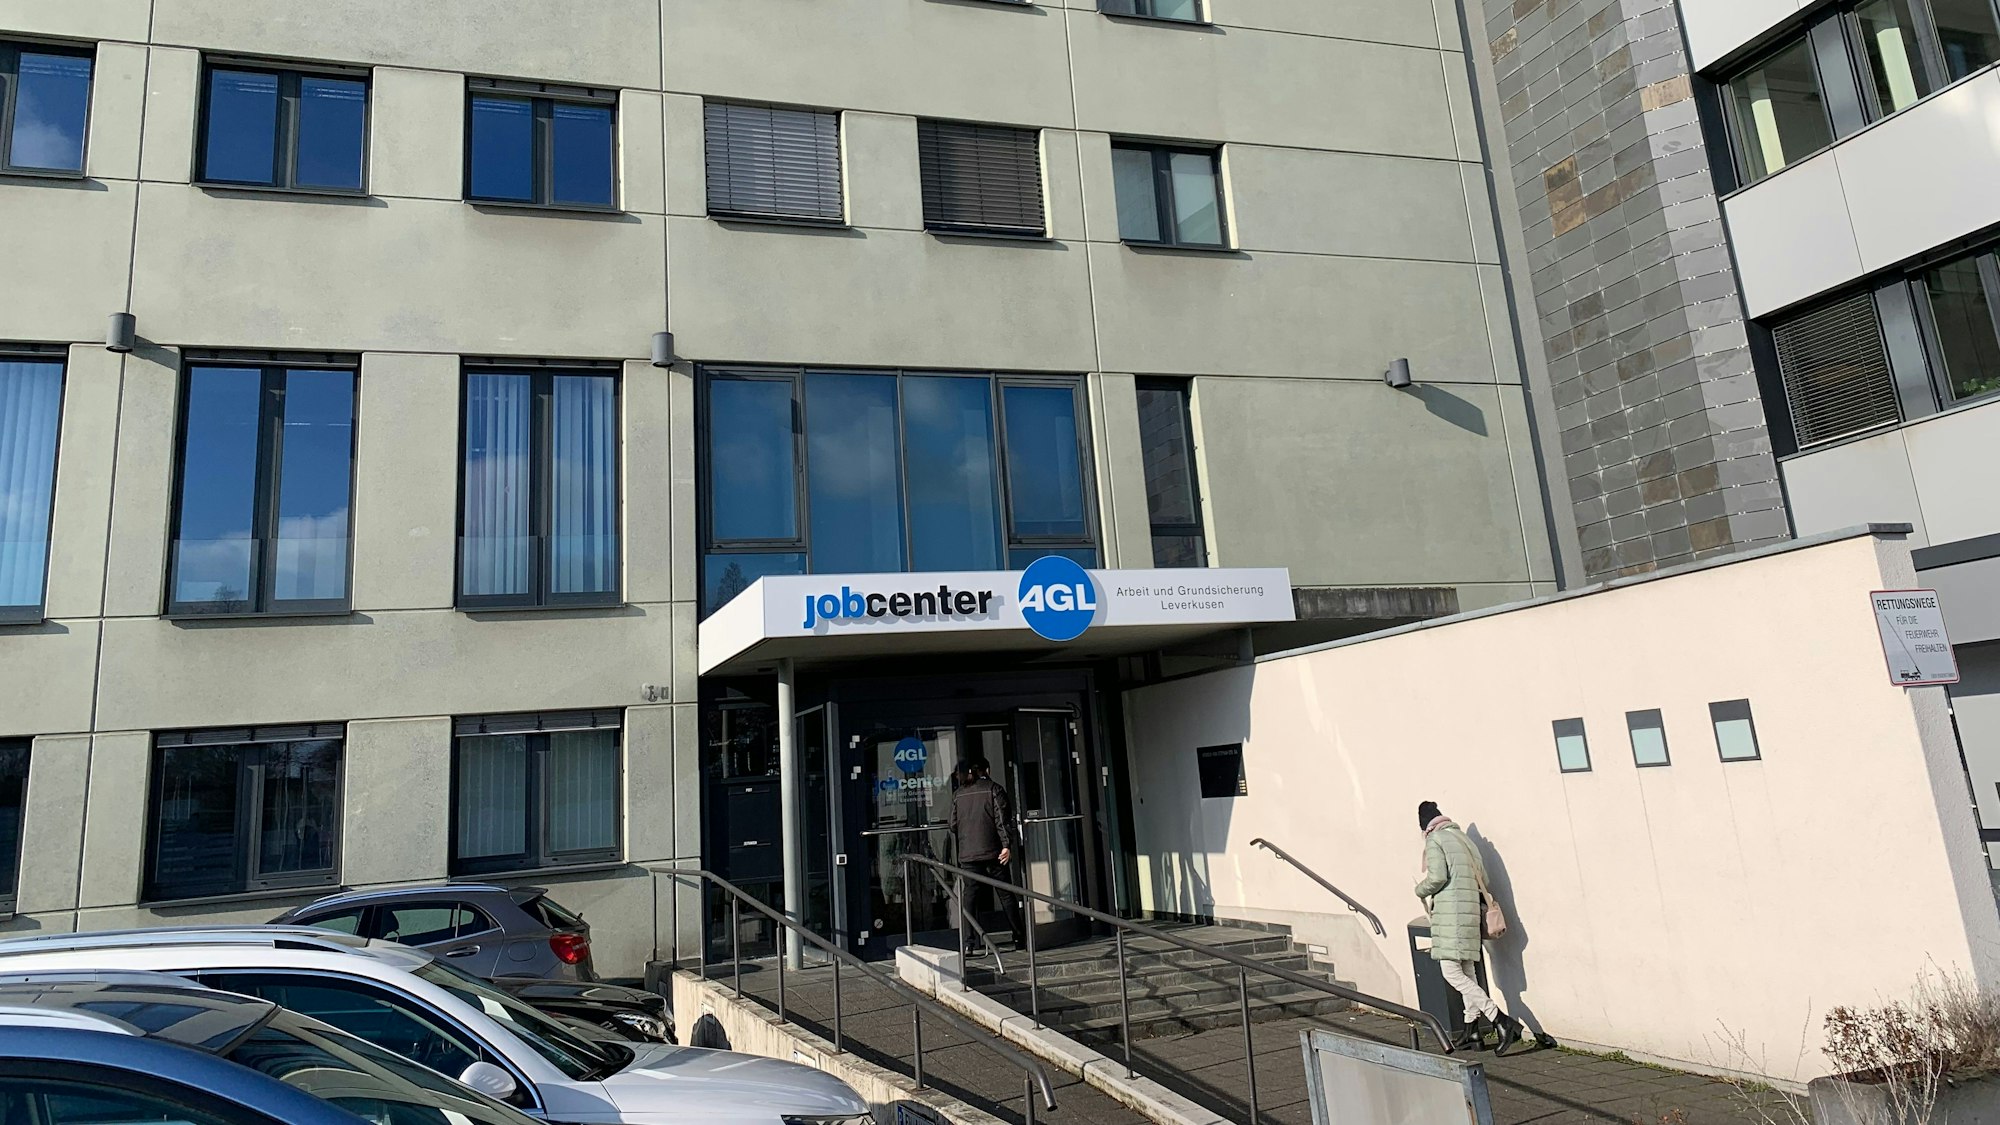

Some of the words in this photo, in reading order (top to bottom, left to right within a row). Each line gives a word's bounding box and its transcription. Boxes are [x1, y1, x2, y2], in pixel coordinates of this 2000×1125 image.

[1116, 586, 1149, 597] Arbeit
[1153, 586, 1174, 596] und
[1178, 585, 1264, 597] Grundsicherung
[803, 585, 992, 629] jobcenter
[1019, 583, 1097, 612] AGL
[1161, 600, 1224, 610] Leverkusen
[1876, 597, 1936, 610] RETTUNGSWEGE
[1896, 614, 1908, 625] FÜR
[1908, 615, 1918, 625] DIE
[1905, 629, 1939, 639] FEUERWEHR
[1914, 643, 1948, 653] FREIHALTEN
[894, 748, 927, 761] AGL
